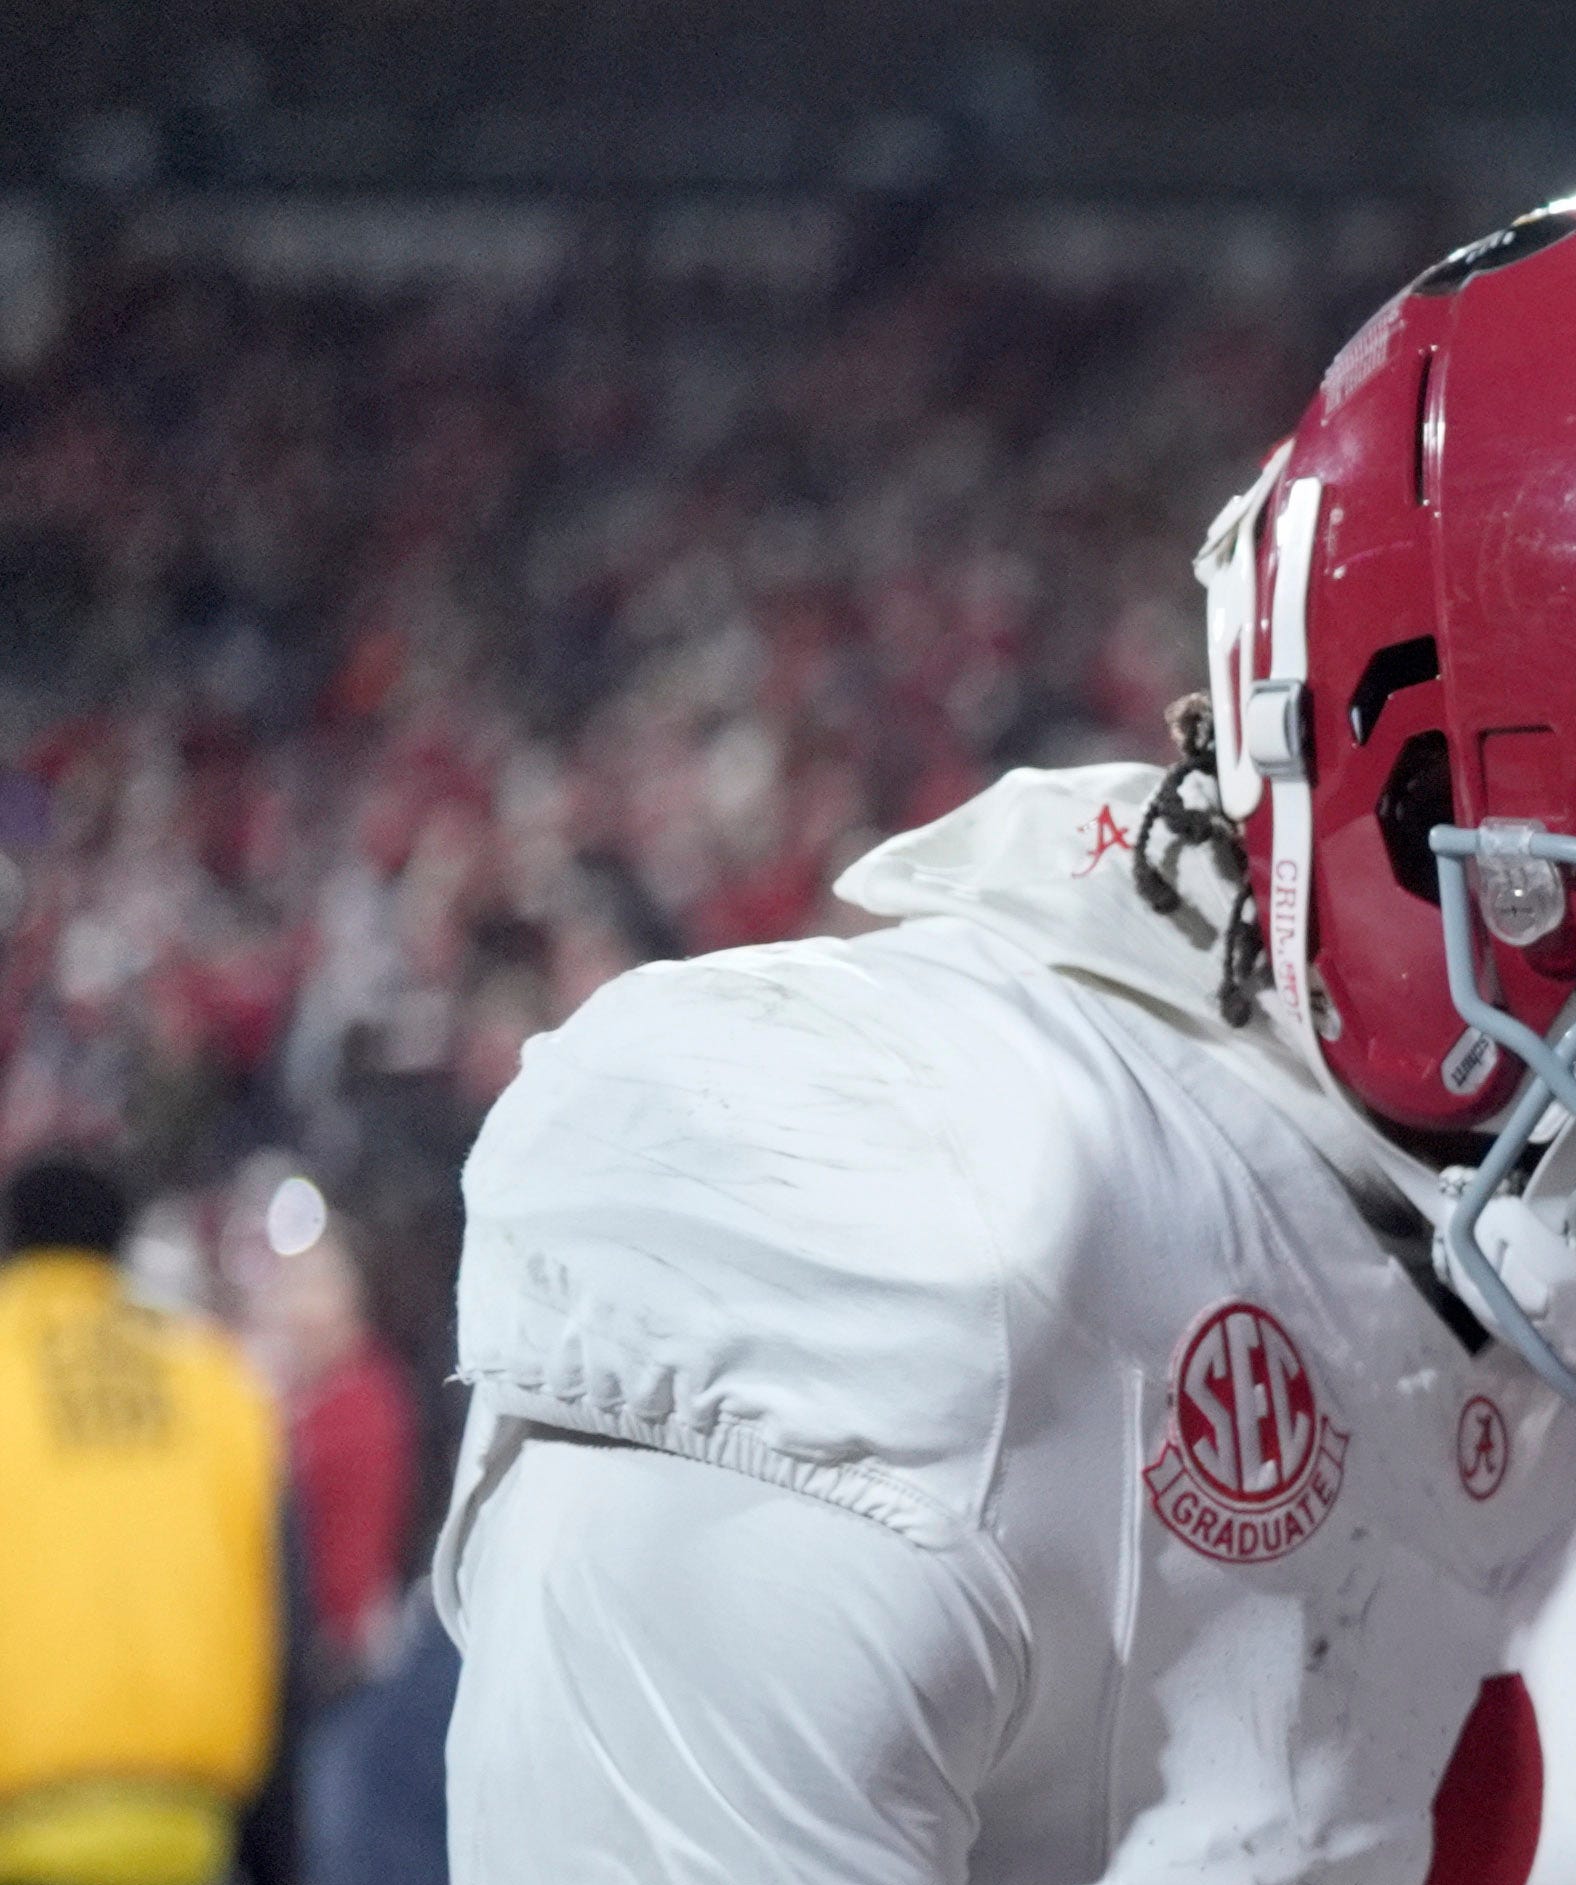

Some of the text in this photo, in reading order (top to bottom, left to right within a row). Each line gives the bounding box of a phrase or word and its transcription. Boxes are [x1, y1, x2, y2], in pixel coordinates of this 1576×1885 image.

[1071, 803, 1138, 880] A
[1183, 1311, 1312, 1492] SEC
[1172, 1471, 1336, 1556] GRADUATE
